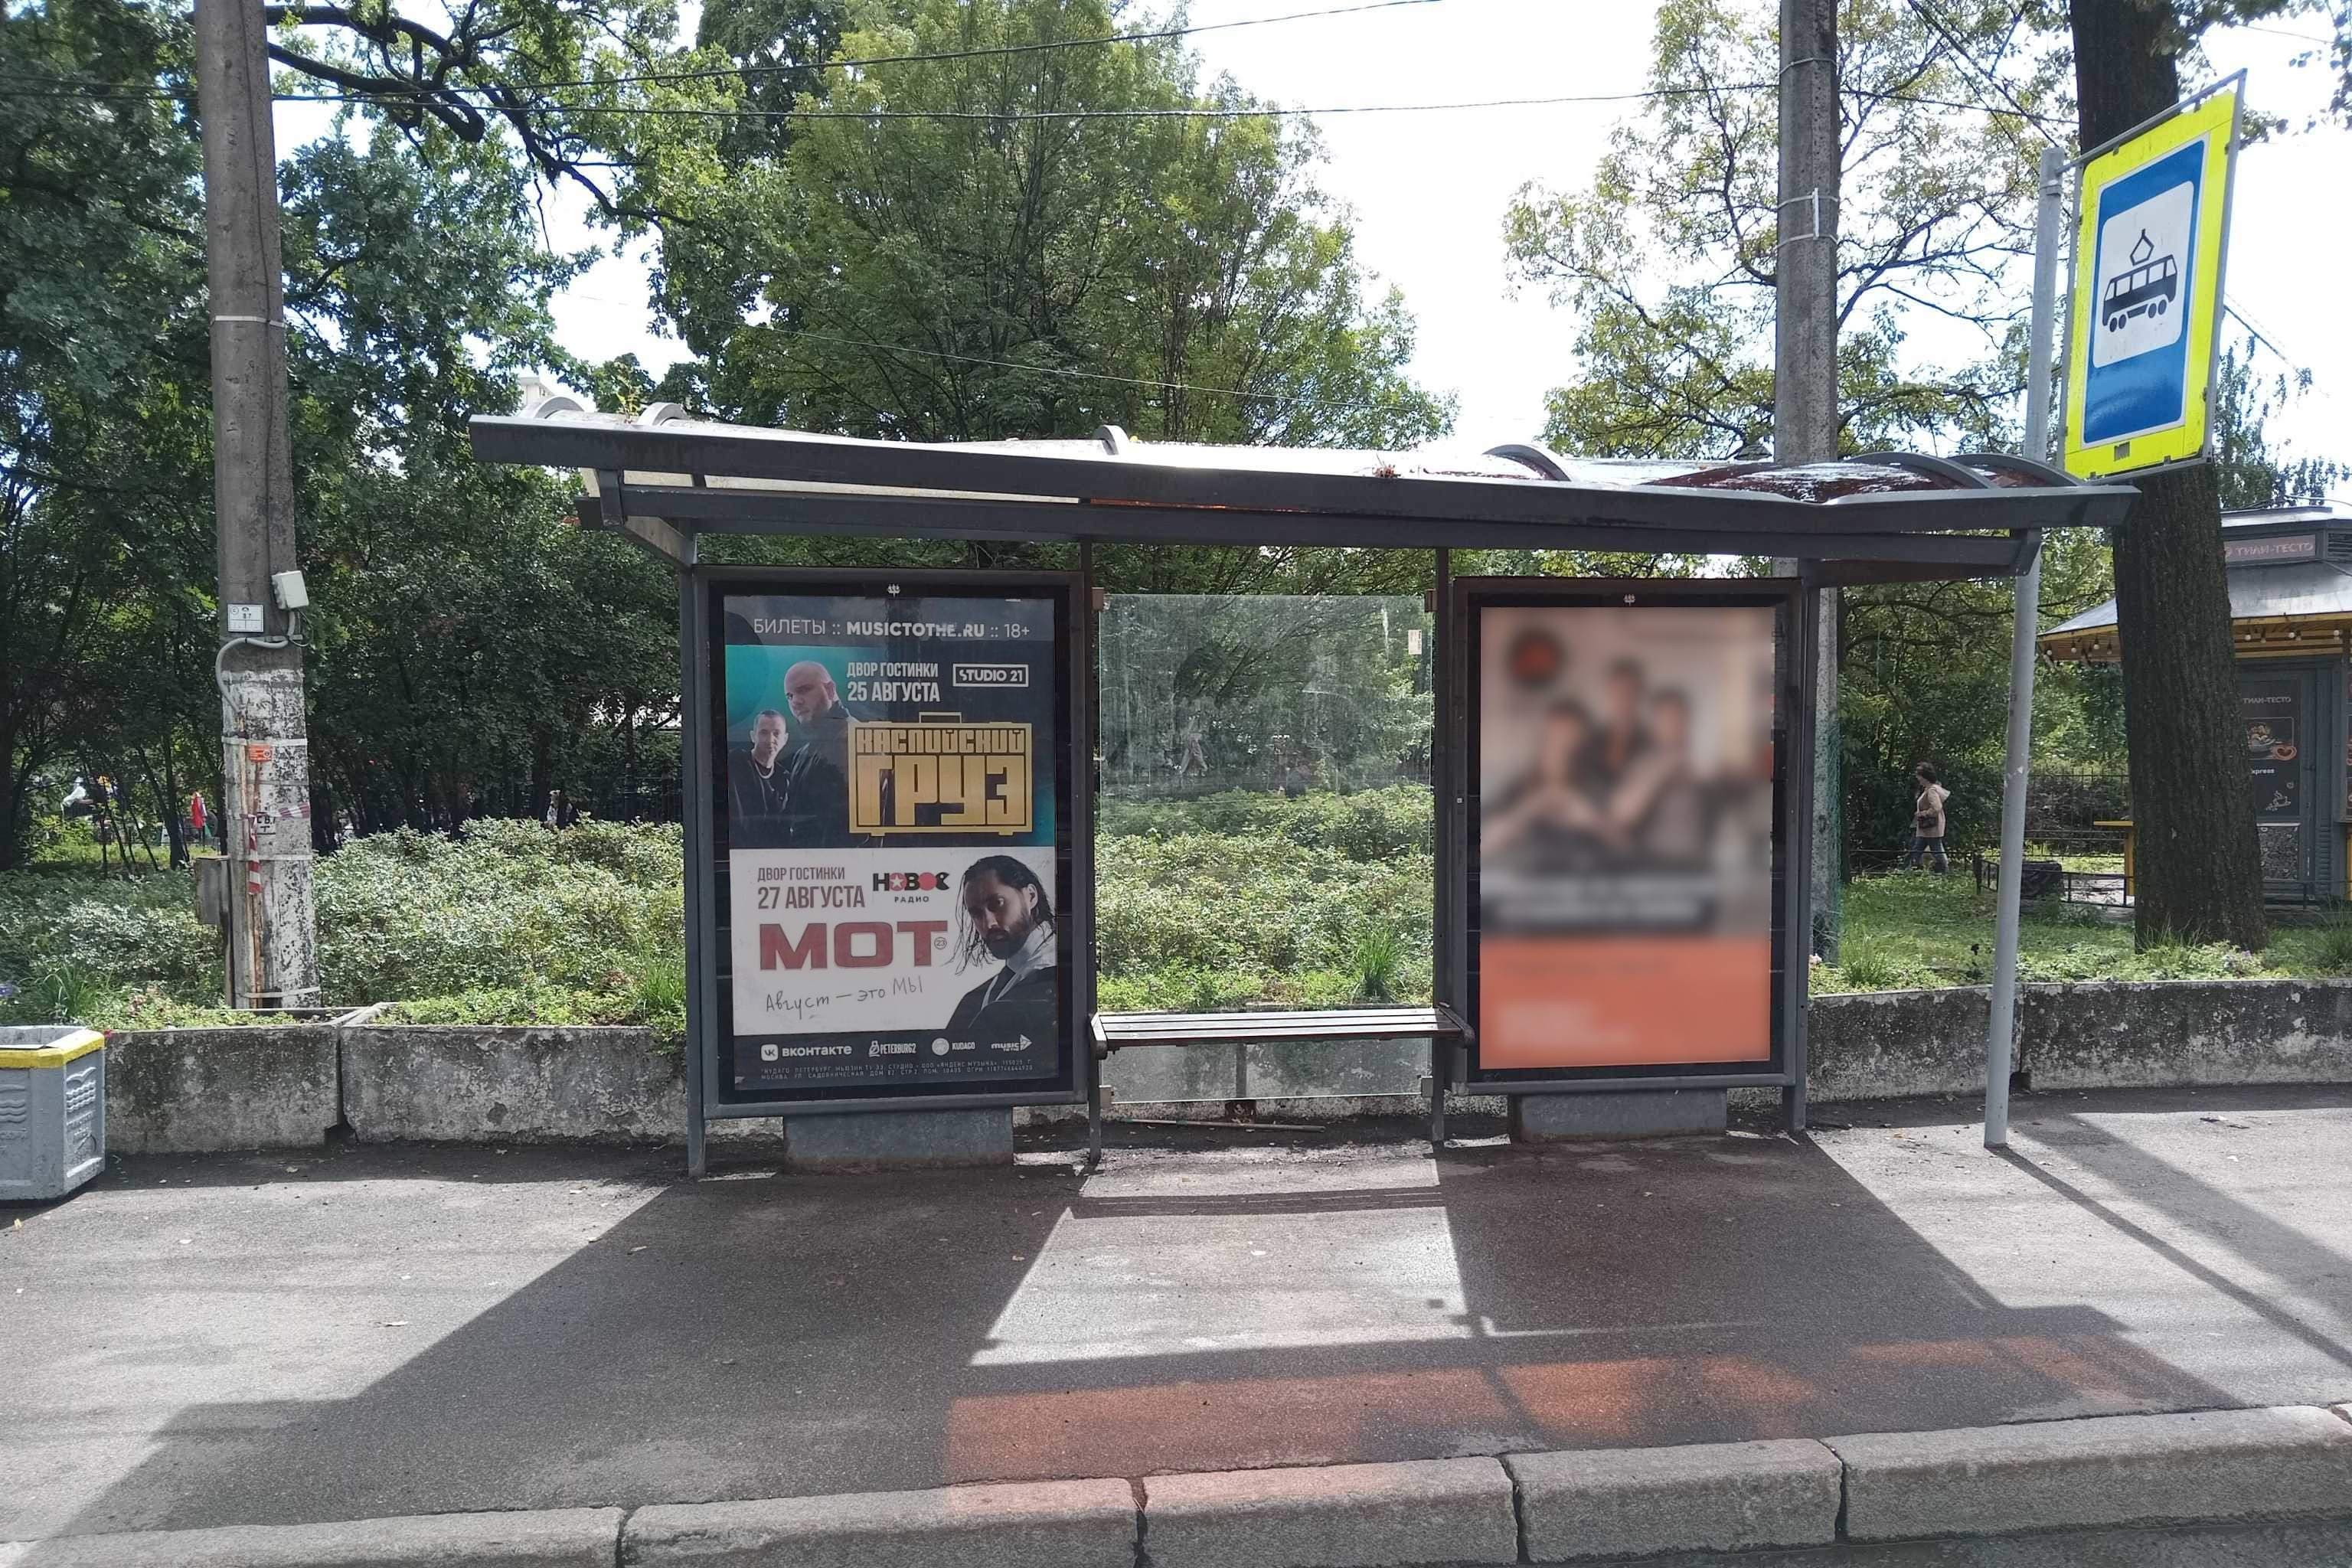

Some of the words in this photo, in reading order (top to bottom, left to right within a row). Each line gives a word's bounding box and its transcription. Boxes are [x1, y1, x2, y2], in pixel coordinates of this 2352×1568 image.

[753, 619, 825, 635] БИЛЕТЫ
[846, 622, 985, 638] MUSICTOTHE.RU
[1004, 624, 1030, 638] 18+
[846, 662, 877, 678] ДВОР
[880, 662, 939, 678] ГОСТИНКИ
[959, 669, 1007, 682] STUDIO
[1010, 669, 1023, 682] 21
[848, 681, 867, 701] 25
[871, 681, 941, 703] АВГУСТА
[855, 729, 1025, 754] КАСПИЙСКИЙ
[856, 755, 1025, 826] ГРУЗ
[757, 867, 786, 882] ДВОР
[789, 867, 845, 880] ГОСТИНКИ
[758, 887, 781, 909] 27
[786, 885, 865, 909] АВГУСТА
[760, 921, 948, 970] МОТ
[766, 990, 829, 1020] Август
[857, 988, 886, 1001] это
[893, 975, 923, 995] МЫ
